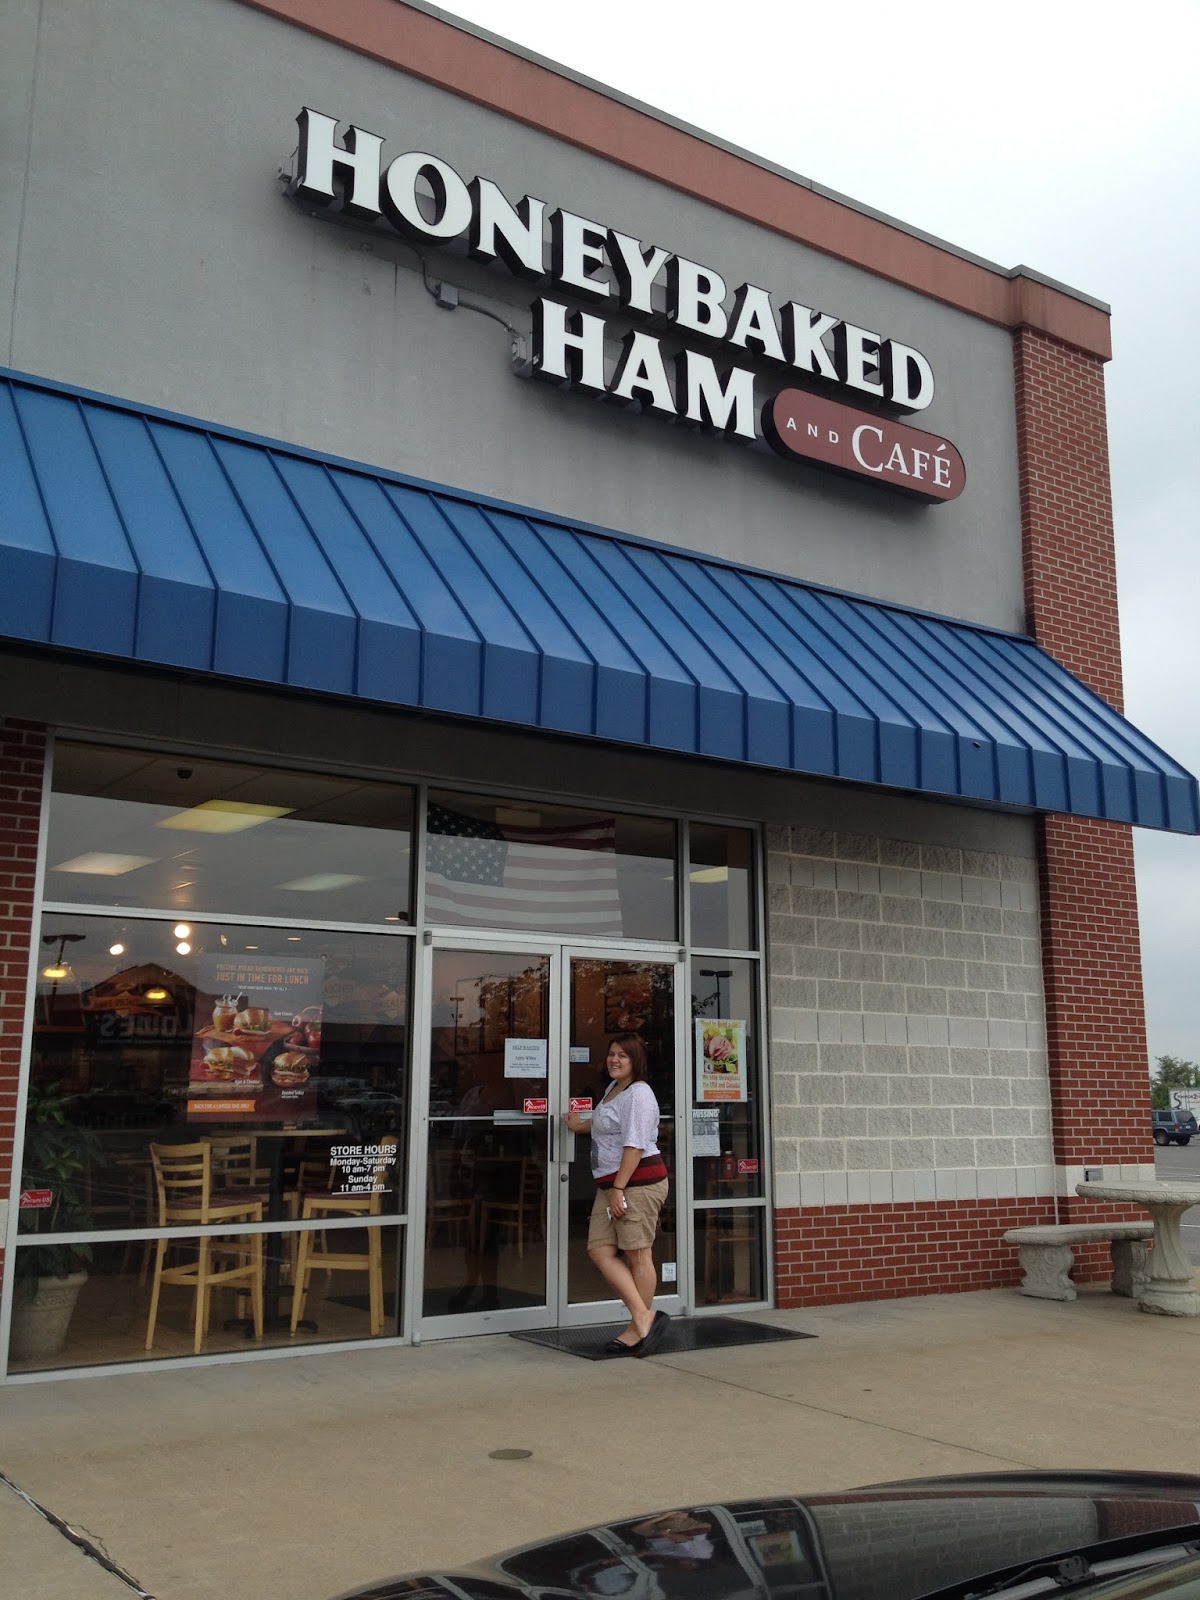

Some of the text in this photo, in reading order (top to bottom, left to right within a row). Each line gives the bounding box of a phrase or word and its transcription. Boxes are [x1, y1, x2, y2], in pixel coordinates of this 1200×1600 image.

[298, 107, 935, 411] HONEYBAKED
[536, 297, 757, 440] HAM
[786, 416, 952, 489] AND CAFÉ
[216, 972, 309, 985] JUST IN TIME FOR LUNCH
[692, 1110, 719, 1118] MISSING
[330, 1145, 397, 1156] STORE HOURS
[330, 1157, 396, 1166] Monday-Saturday
[341, 1165, 385, 1174] 10 am-7 pm
[348, 1175, 377, 1183] Sunday
[340, 1183, 385, 1192] 11 am-4 pm
